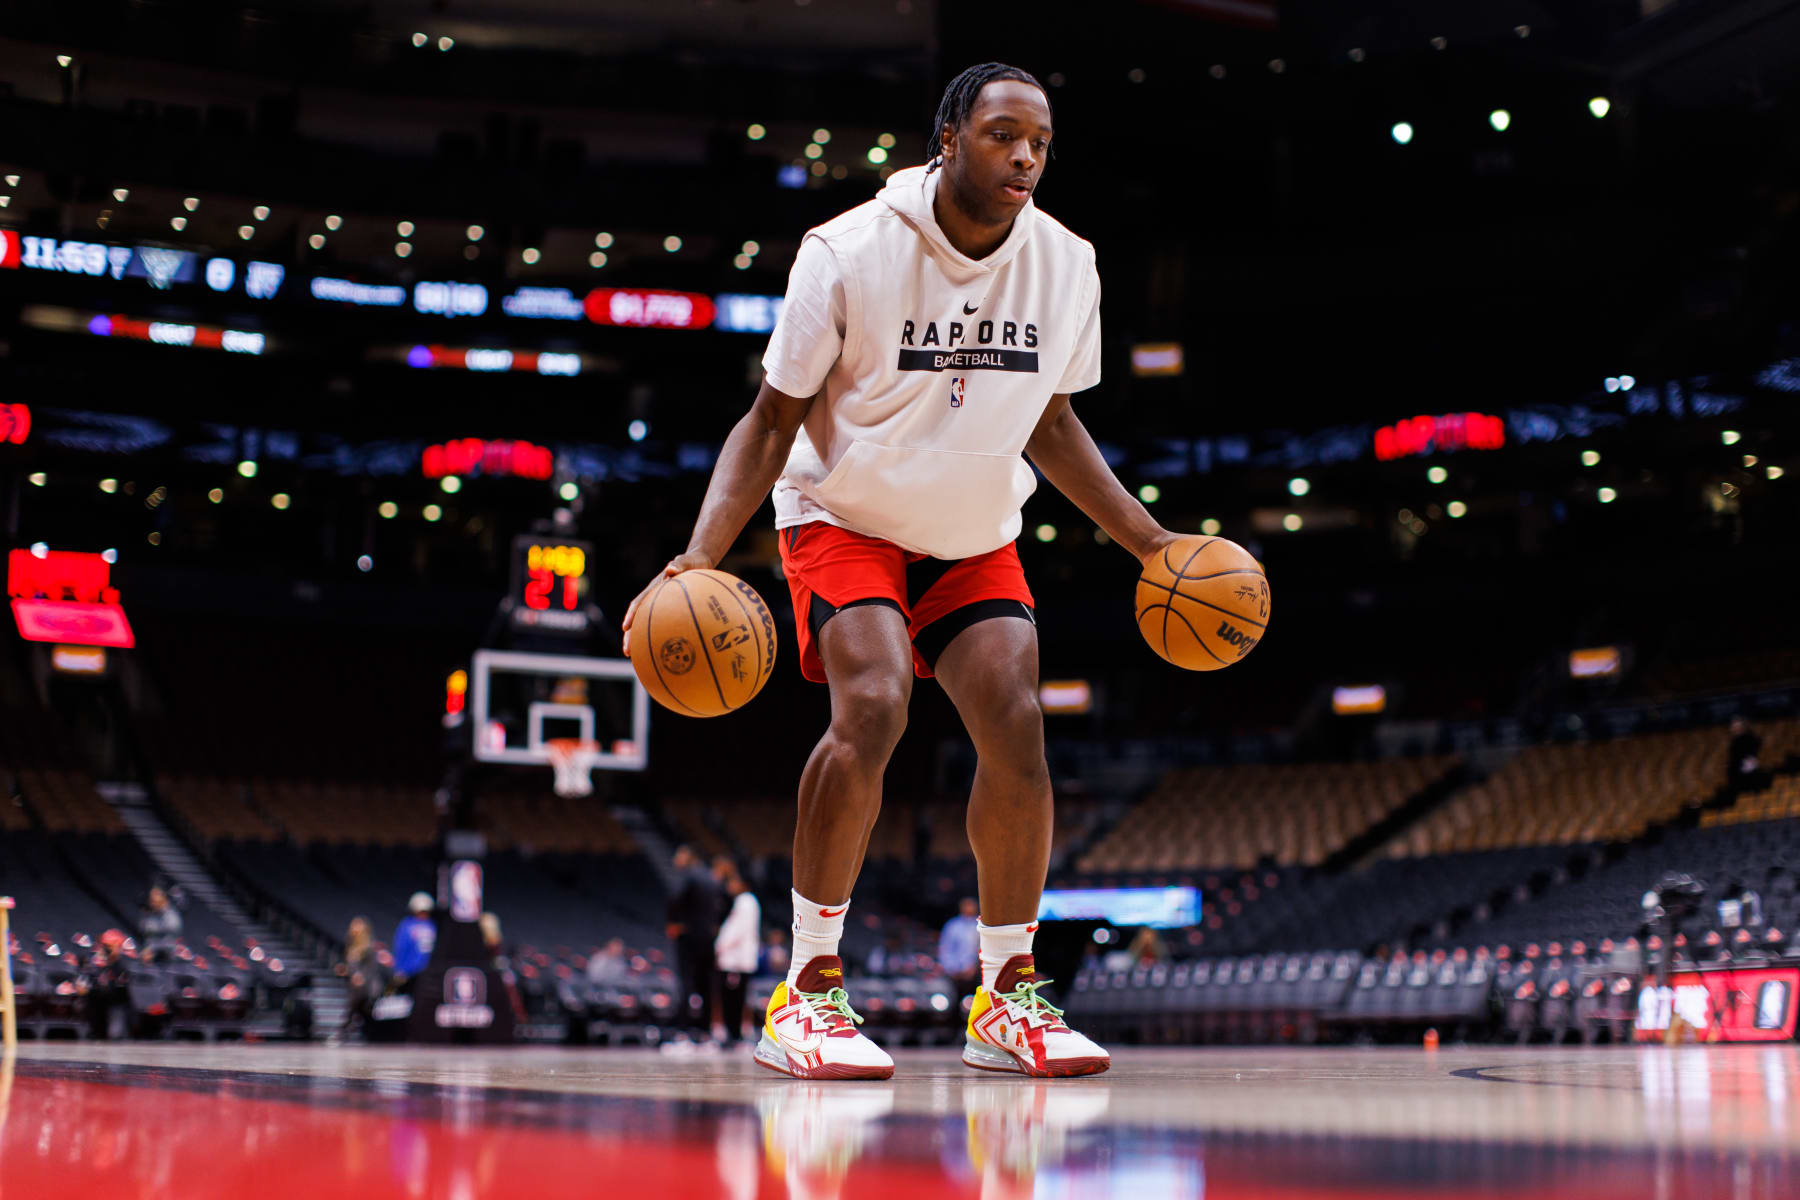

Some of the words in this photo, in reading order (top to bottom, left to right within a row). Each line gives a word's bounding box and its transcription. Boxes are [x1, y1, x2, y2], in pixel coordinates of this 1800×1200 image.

[901, 319, 1038, 348] RAPORS
[934, 353, 1005, 368] BAKETBALL
[1216, 620, 1259, 657] lson
